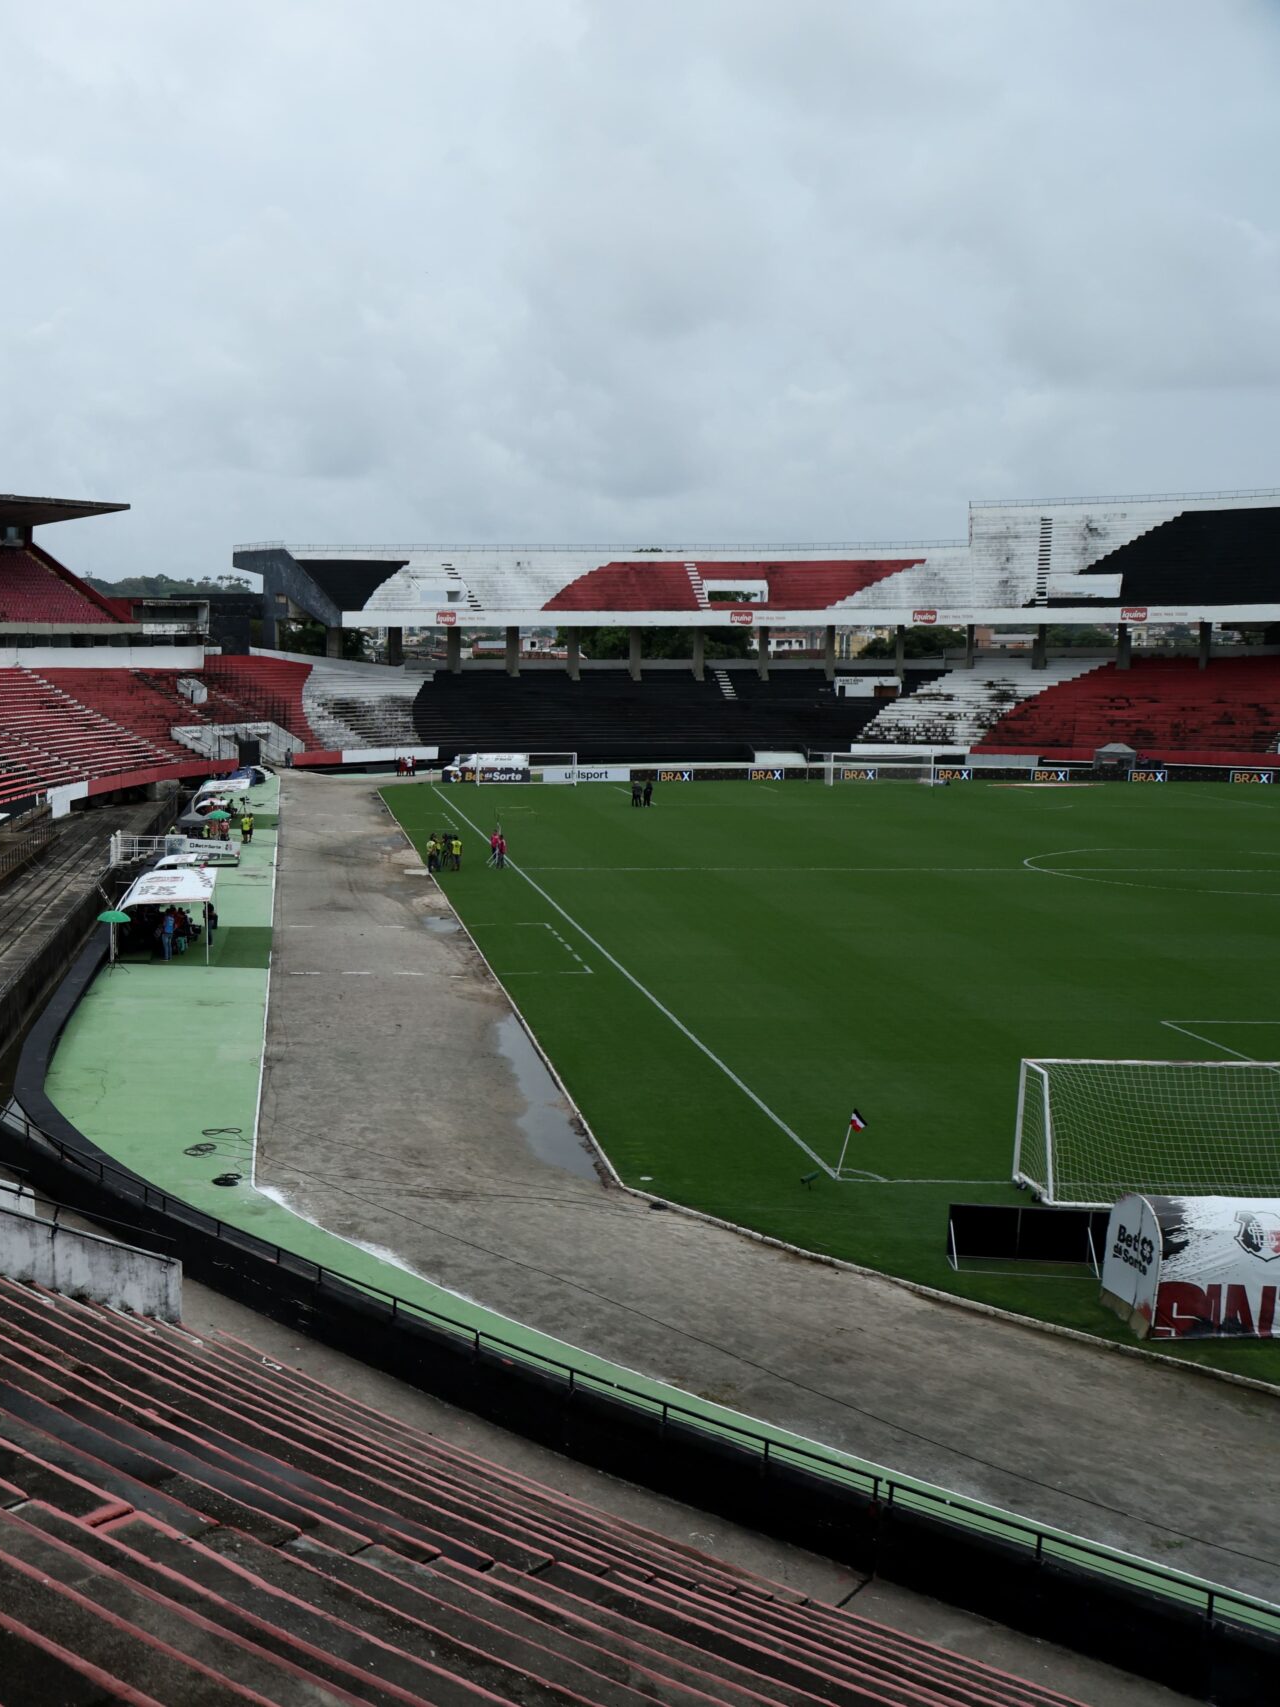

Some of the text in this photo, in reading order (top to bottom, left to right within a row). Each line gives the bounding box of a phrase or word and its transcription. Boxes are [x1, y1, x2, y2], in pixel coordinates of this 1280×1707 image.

[492, 771, 522, 781] Sorte
[660, 771, 690, 781] BRAX
[752, 770, 781, 780] BRAX
[844, 770, 874, 780] BRAX
[939, 770, 969, 780] BRAX
[1034, 771, 1066, 781] BRAX
[1131, 772, 1164, 782] BRAX
[1234, 773, 1269, 783] BRAX
[1117, 1224, 1140, 1251] Bet
[1122, 1248, 1147, 1276] Sorte
